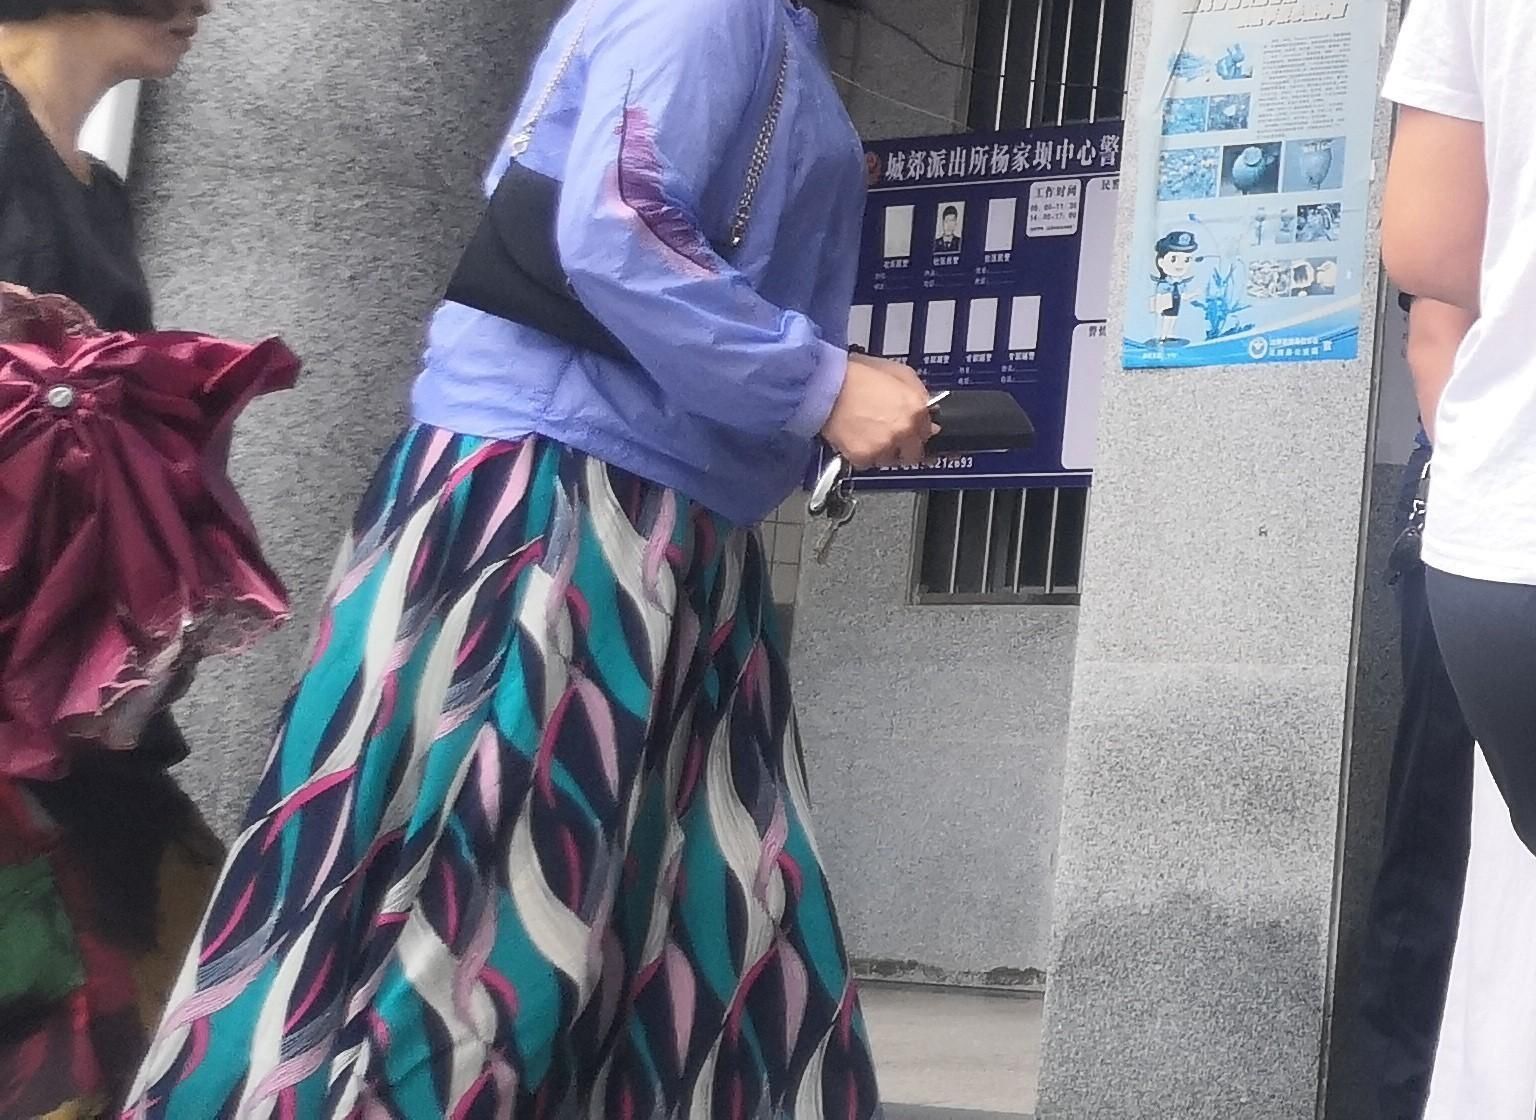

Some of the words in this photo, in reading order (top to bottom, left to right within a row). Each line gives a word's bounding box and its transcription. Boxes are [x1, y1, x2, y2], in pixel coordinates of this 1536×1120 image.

[884, 134, 1121, 182] 城郊派出所杨家坝中心警
